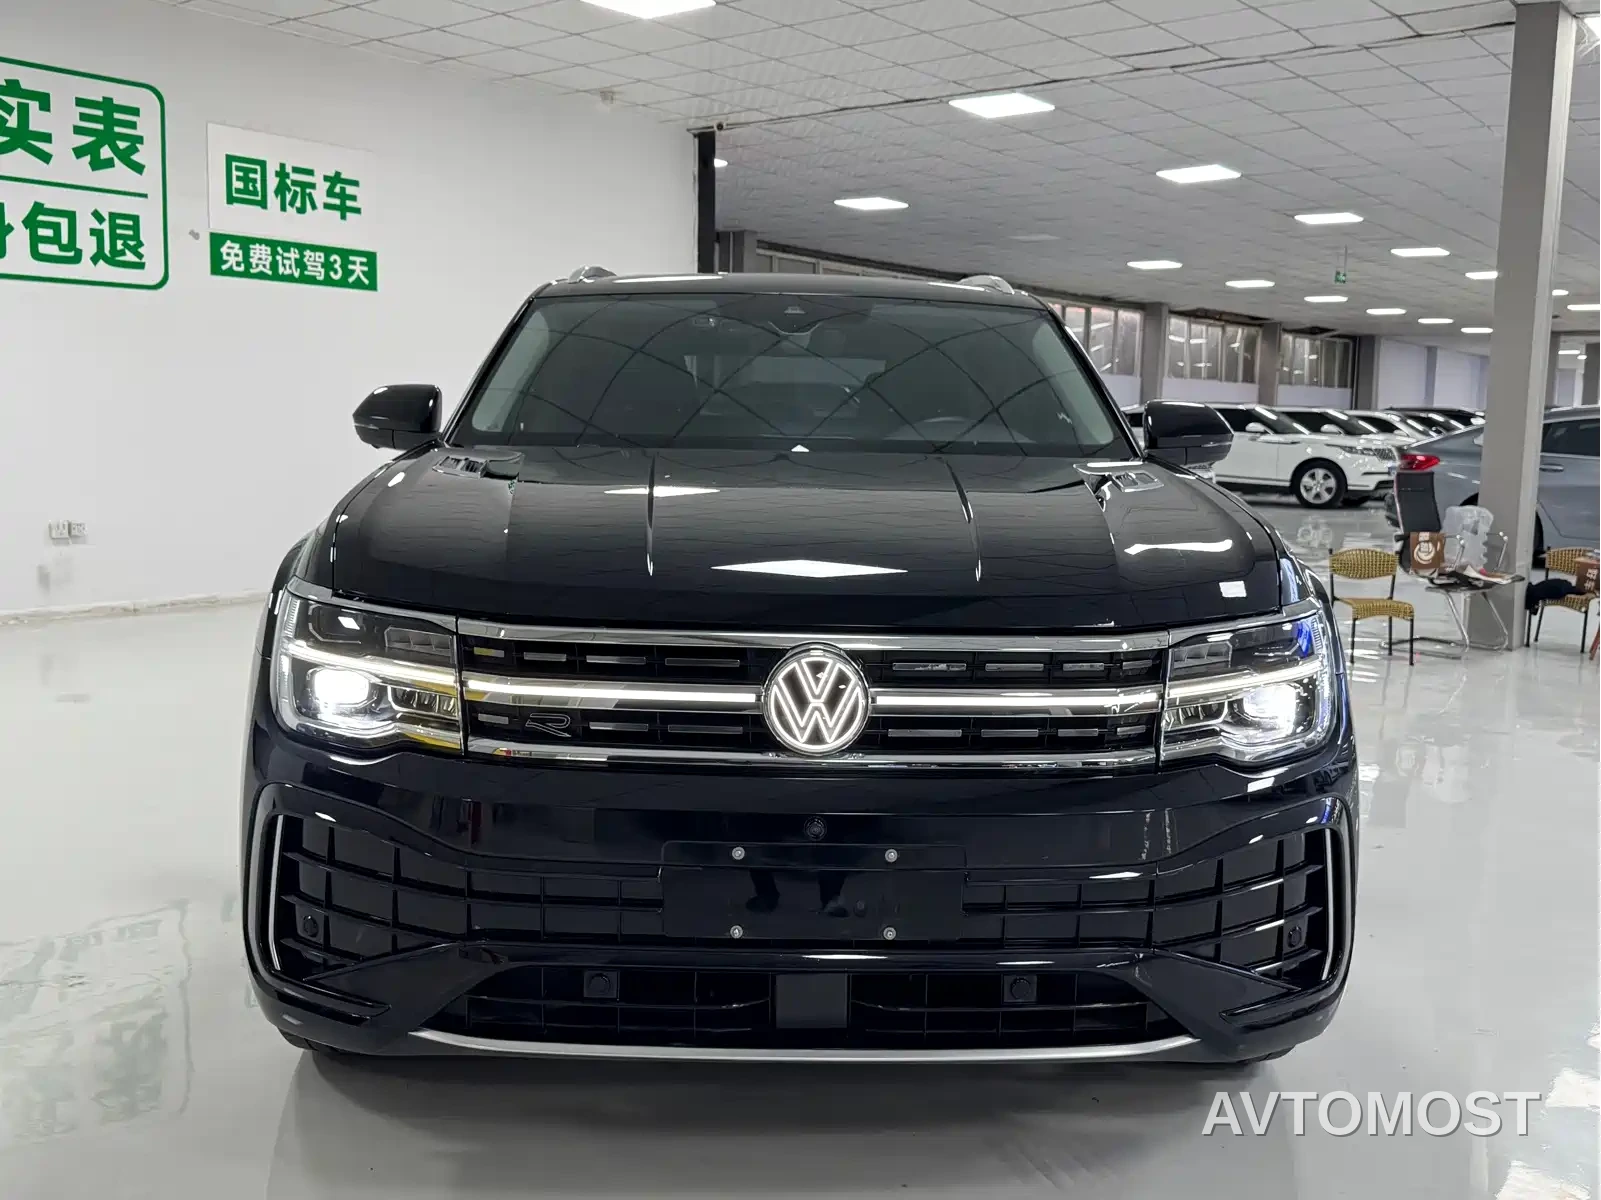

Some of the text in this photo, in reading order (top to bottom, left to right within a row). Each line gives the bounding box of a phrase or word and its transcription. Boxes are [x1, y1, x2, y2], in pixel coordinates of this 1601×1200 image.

[225, 153, 362, 221] 国标车
[0, 201, 146, 270] 包退
[219, 239, 370, 286] 免费试驾3天
[765, 655, 865, 752] VW
